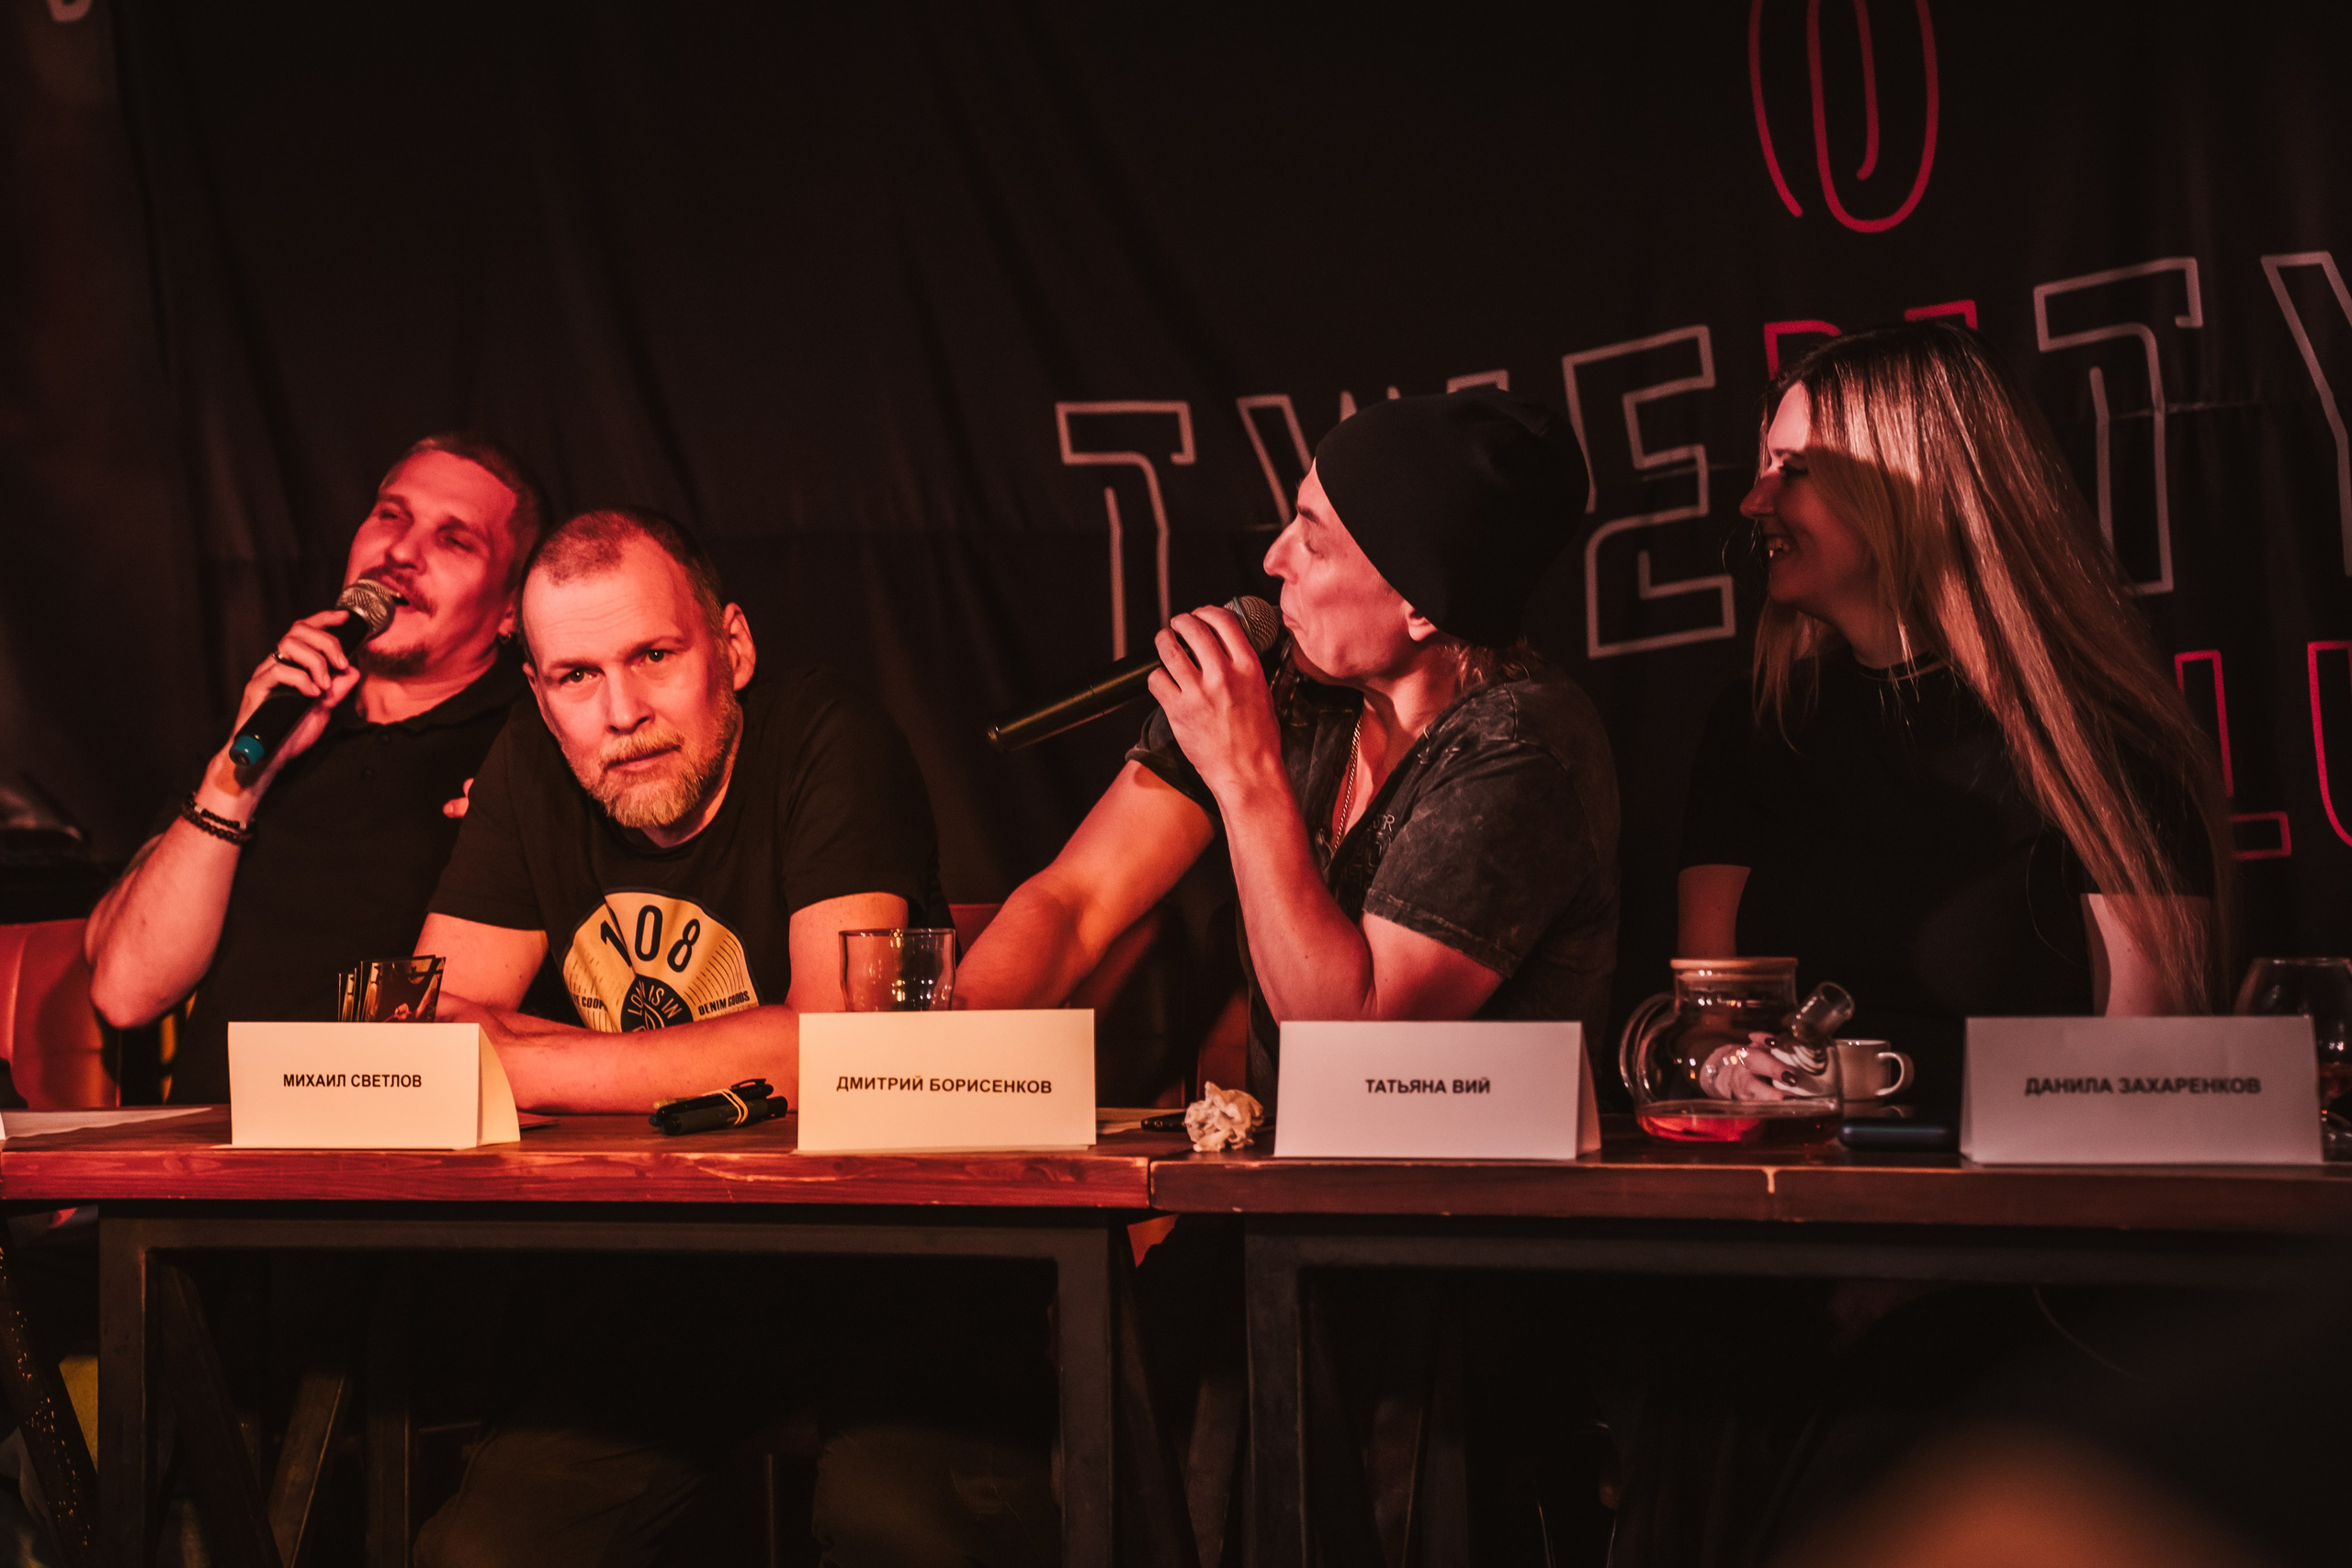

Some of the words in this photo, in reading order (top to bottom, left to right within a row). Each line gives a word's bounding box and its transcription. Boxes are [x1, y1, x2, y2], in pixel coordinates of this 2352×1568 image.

[600, 905, 701, 973] 108
[648, 985, 665, 1007] IS
[662, 998, 683, 1019] IN
[698, 998, 727, 1016] DENIM
[728, 990, 751, 1008] GOODS
[284, 1074, 345, 1087] МИХАИЛ
[351, 1075, 422, 1088] СВЕТЛОВ
[836, 1076, 922, 1091] ДМИТРИЙ
[930, 1078, 1052, 1093] БОРИСЕНКОВ
[1365, 1079, 1447, 1094] ТАТЬЯНА
[1453, 1077, 1490, 1094] ВИЙ
[2025, 1077, 2113, 1096] ДАНИЛА
[2119, 1077, 2261, 1094] ЗАХАРЕНКОВ
